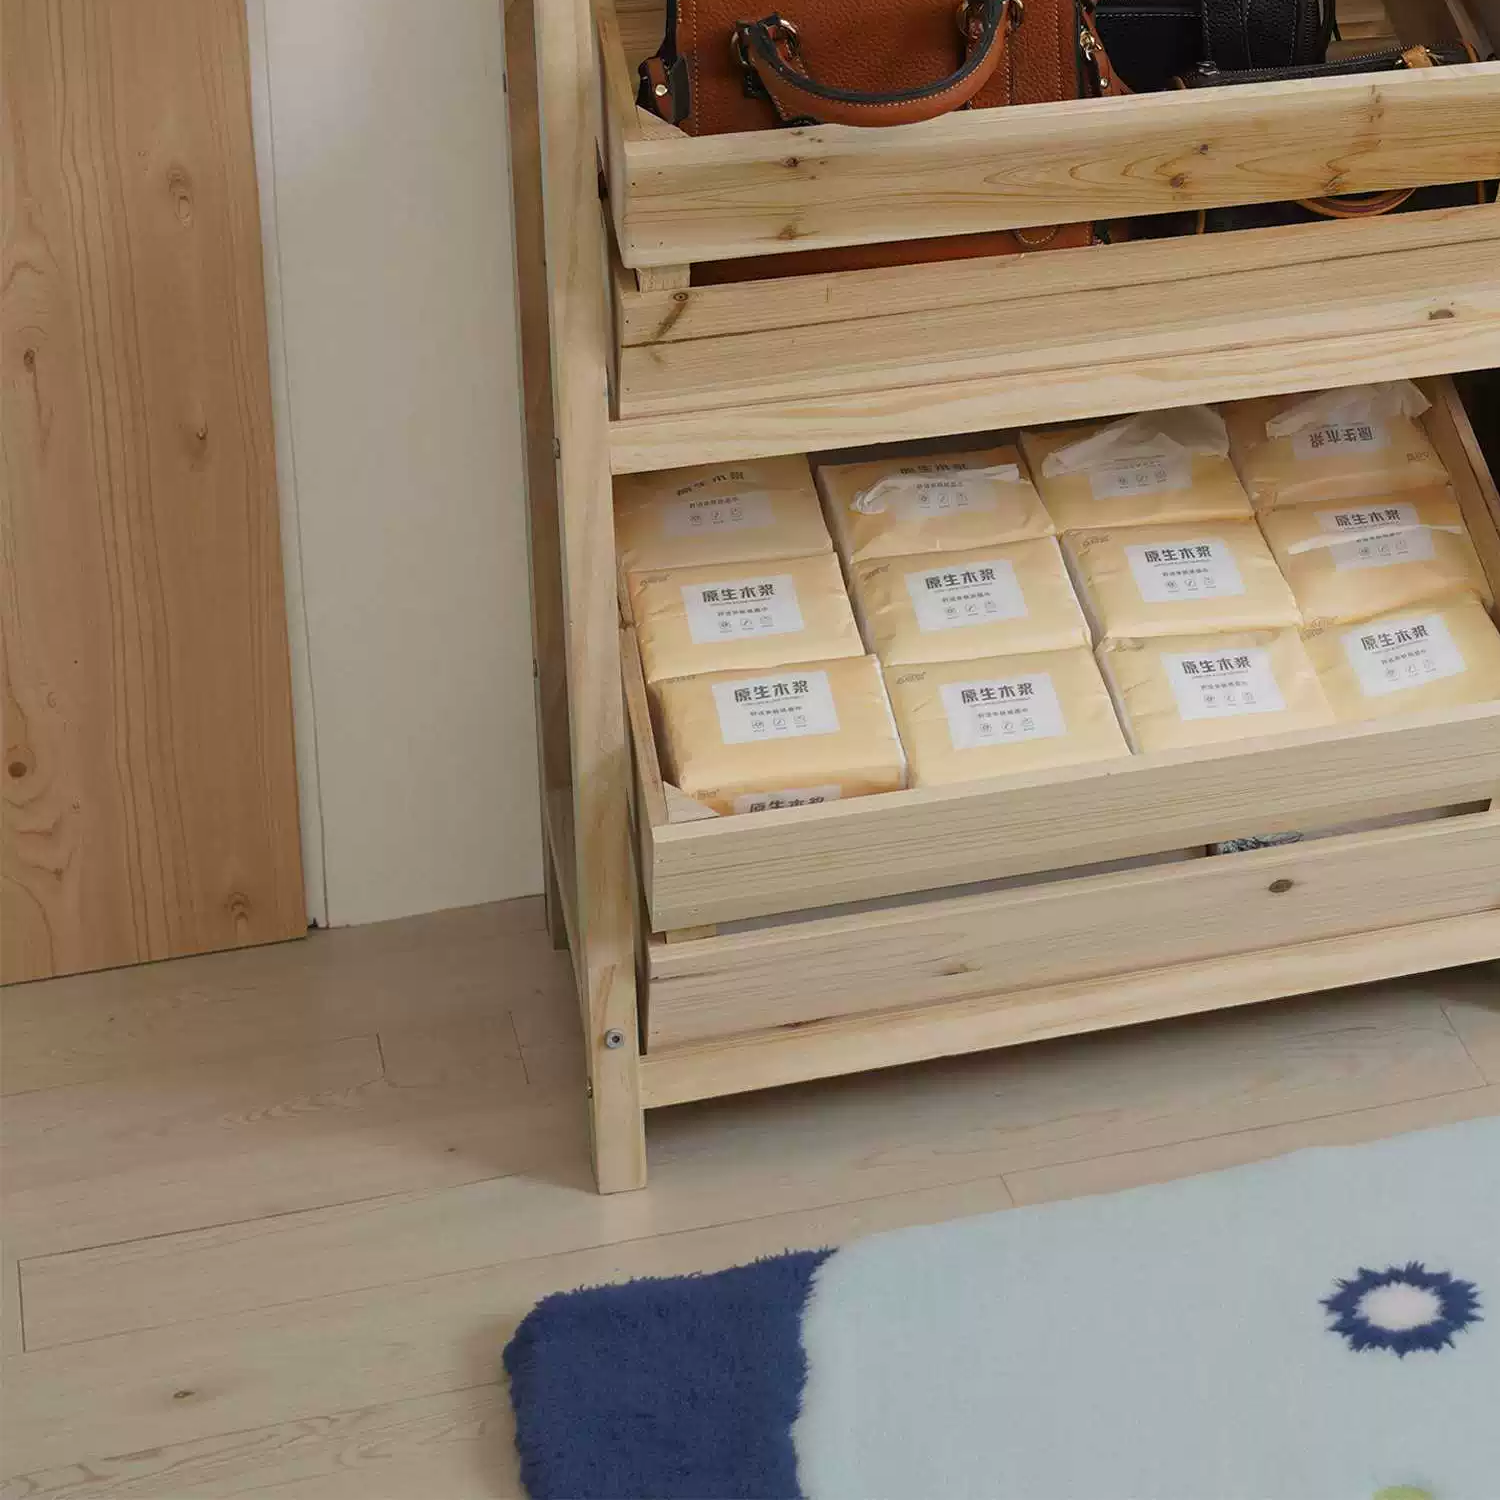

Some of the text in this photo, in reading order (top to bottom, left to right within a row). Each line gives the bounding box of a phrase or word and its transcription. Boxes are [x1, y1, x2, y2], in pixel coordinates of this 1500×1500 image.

[1144, 545, 1212, 563] 原生木浆
[924, 568, 996, 590] 原生木浆
[702, 583, 776, 603] 原生木浆
[1360, 624, 1430, 652] 原生木浆
[1181, 655, 1252, 675] 原生木浆
[734, 680, 809, 703] 原生木浆
[961, 682, 1034, 705] 原生木浆
